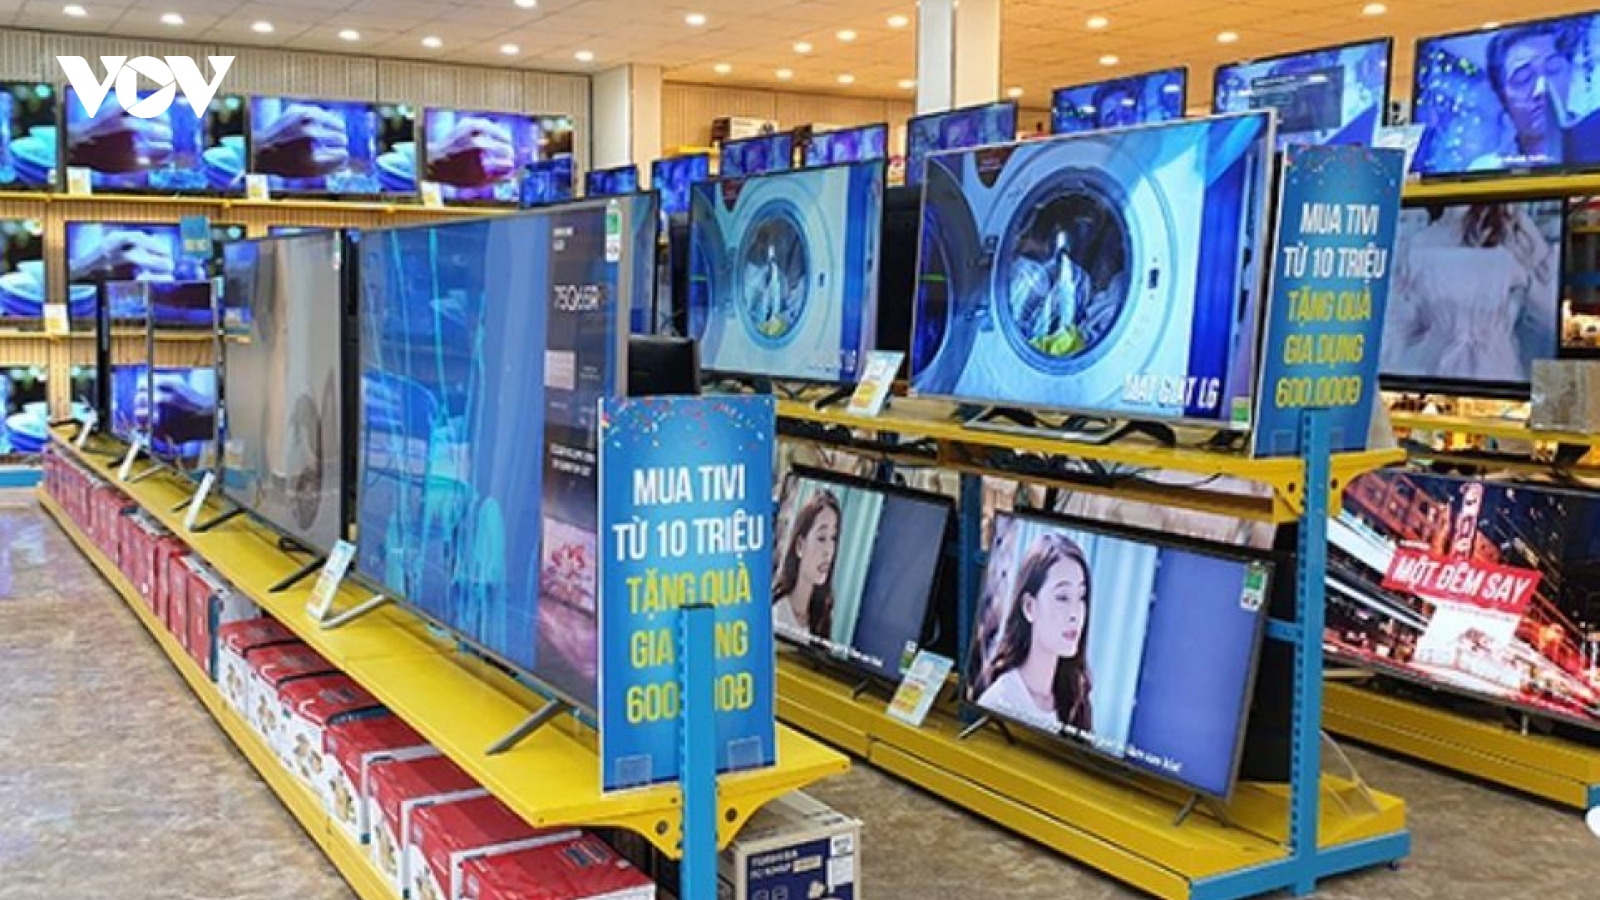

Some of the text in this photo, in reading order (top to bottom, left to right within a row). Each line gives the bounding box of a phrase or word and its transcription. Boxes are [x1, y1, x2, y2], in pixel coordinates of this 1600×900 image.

[1299, 202, 1380, 235] MUA TIVI
[1283, 241, 1388, 284] TỪ 10 TRIỆU
[1287, 285, 1371, 328] TẶNG QUÀ
[1283, 334, 1364, 369] GIA DỤNG
[1198, 377, 1220, 409] LG
[633, 466, 693, 506] MUA
[698, 464, 746, 501] TIVI
[612, 508, 764, 562] TỪ 10 TRIỆU
[626, 561, 752, 620] TẶNG QUÀ
[1391, 554, 1532, 605] MỘT ĐÊM SAY
[631, 628, 675, 669] GIA
